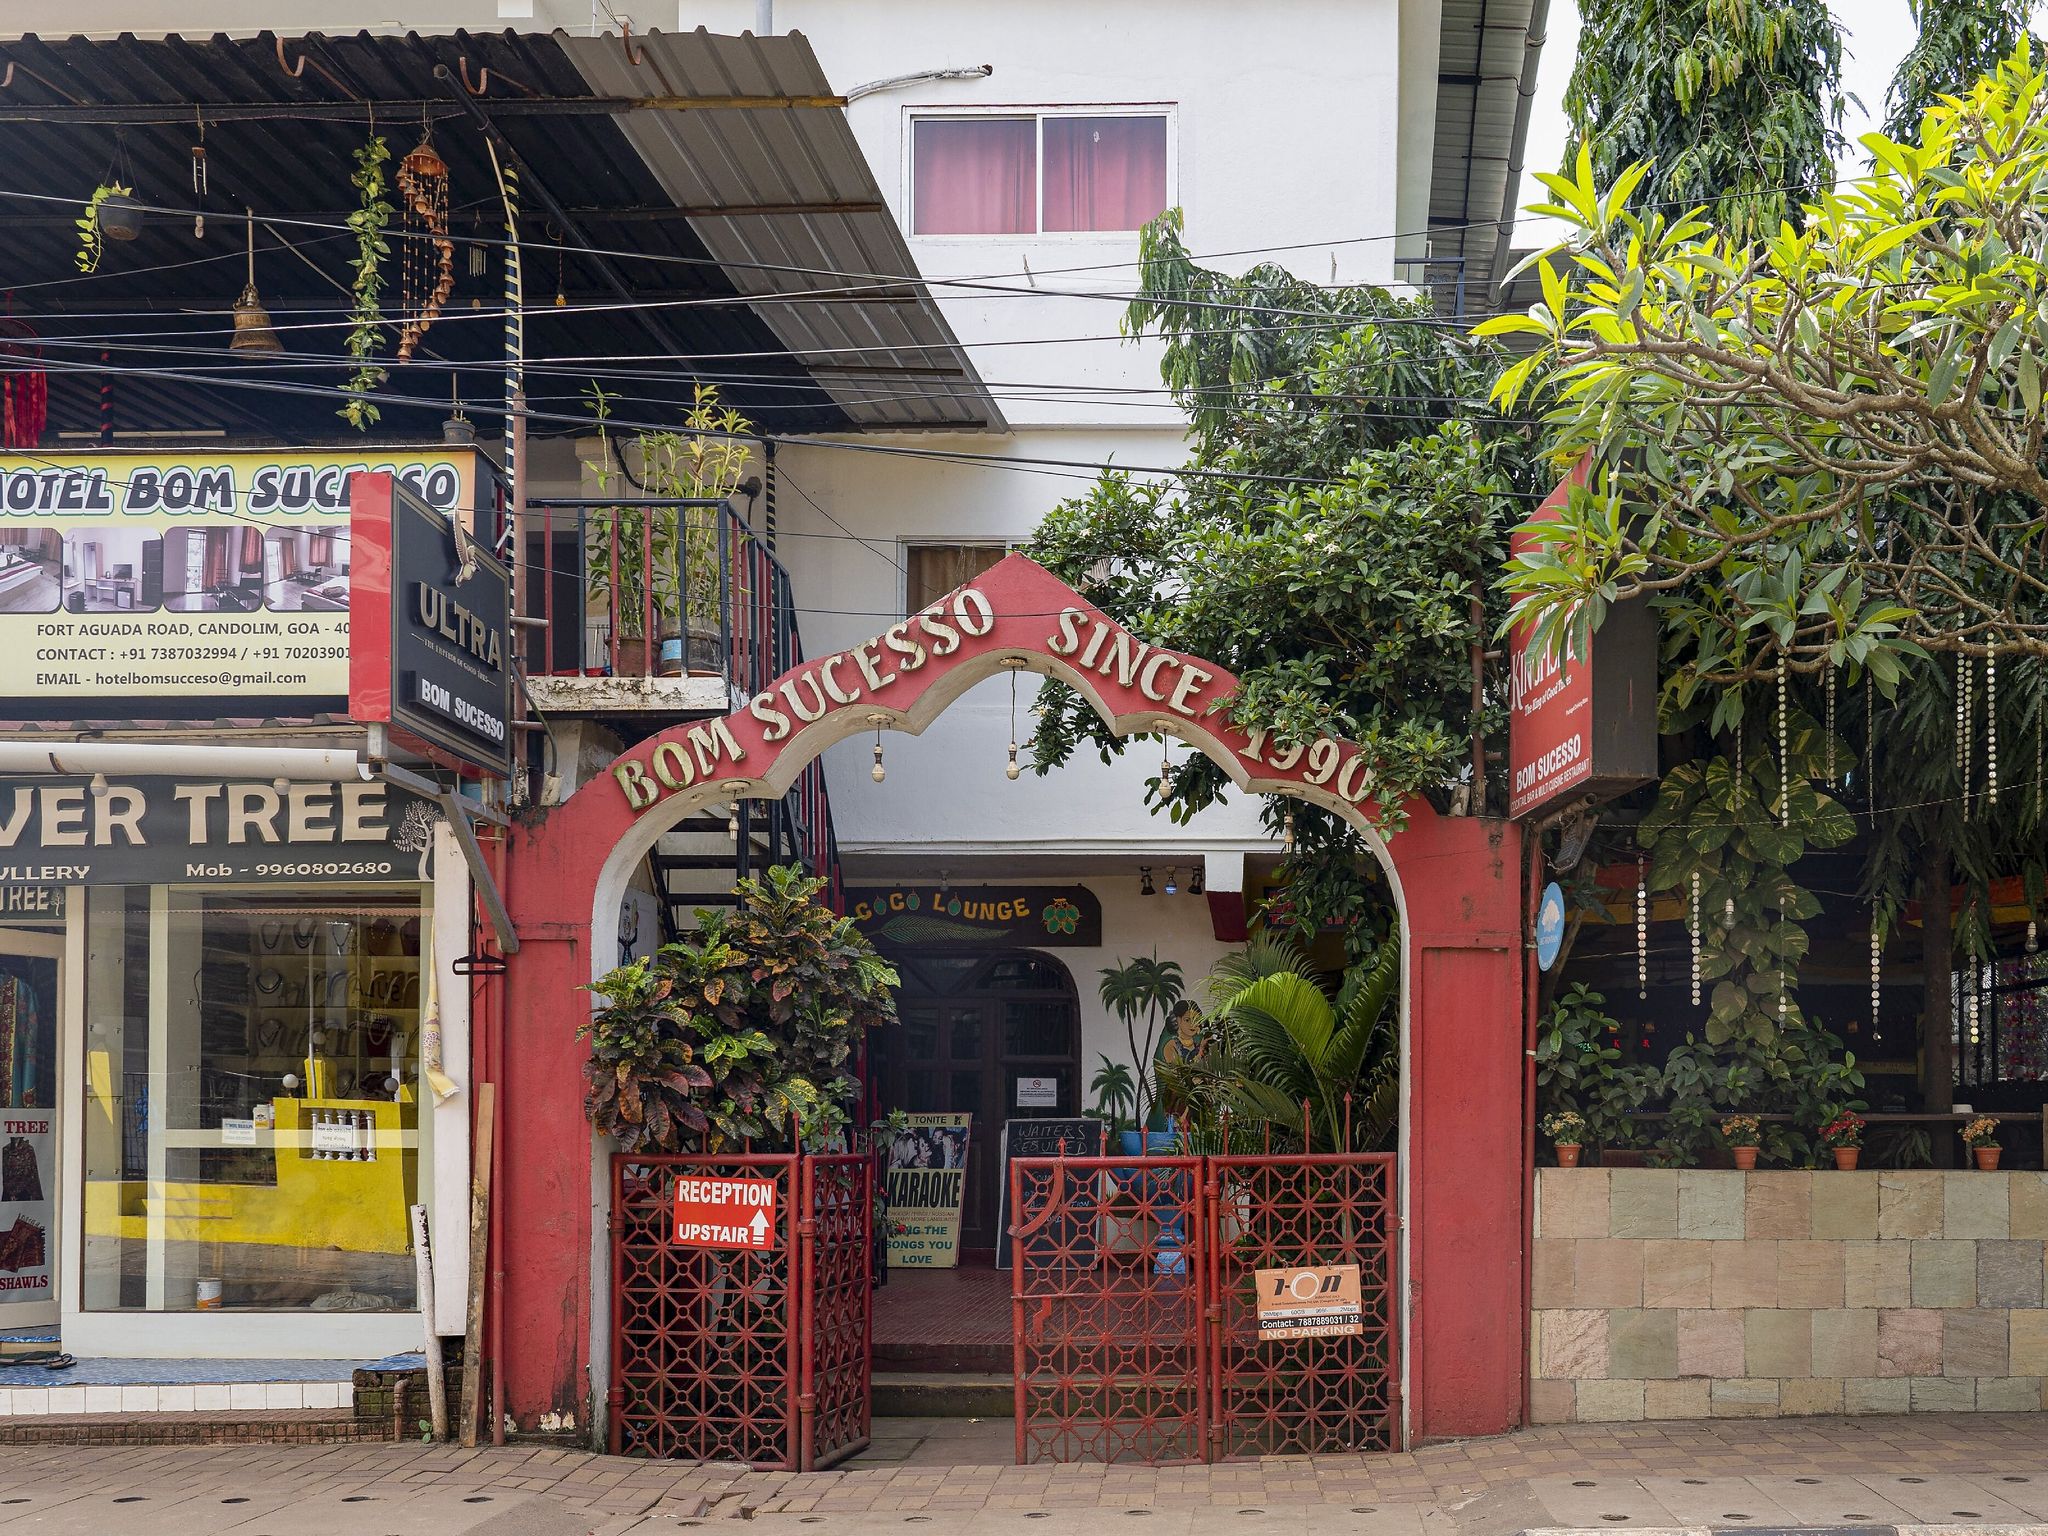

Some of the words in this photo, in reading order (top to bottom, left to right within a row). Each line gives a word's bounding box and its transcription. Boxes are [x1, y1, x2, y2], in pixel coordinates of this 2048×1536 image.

[0, 472, 109, 510] OTEL
[125, 471, 233, 509] BOM
[250, 469, 457, 509] SUCSO
[37, 624, 75, 636] FORT
[78, 623, 143, 636] AGUADA
[147, 623, 193, 637] ROAD,
[198, 622, 283, 637] CANDOLIM,
[287, 622, 320, 634] GOA
[419, 580, 504, 673] ULTRA
[36, 648, 107, 660] CONTACT
[119, 648, 146, 660] +91
[151, 647, 237, 660] 7387032994
[253, 647, 280, 659] +91
[36, 673, 81, 685] EMAIL
[95, 671, 307, 687] hotelbomsucceso@gmail.com
[612, 715, 747, 813] BOM
[750, 587, 996, 743] SUCESSO
[1046, 606, 1214, 719] SINCE
[421, 678, 451, 713] BOM
[454, 696, 505, 742] SUCESSO
[1516, 761, 1536, 793] BOM
[1537, 733, 1581, 780] SUCESSO
[174, 782, 390, 845] TREE
[186, 863, 233, 877] Mob
[255, 861, 392, 877] 9960802680
[933, 892, 1030, 922] LOUNGE
[4, 1120, 49, 1134] TREE
[914, 1115, 947, 1125] TONITE
[1018, 1124, 1086, 1140] WAITERS
[678, 1180, 773, 1207] RECEPTION
[887, 1171, 963, 1208] KARAOKE
[678, 1223, 749, 1244] UPSTAIR
[924, 1226, 948, 1235] THE
[887, 1240, 925, 1249] SONGS
[928, 1240, 953, 1250] YOU
[902, 1255, 933, 1264] LOVE
[0, 1275, 49, 1291] SHAWLS
[1261, 1319, 1295, 1329] Contact:
[1349, 1314, 1359, 1324] 32
[1266, 1329, 1288, 1339] NO
[1291, 1325, 1355, 1337] PARKING
